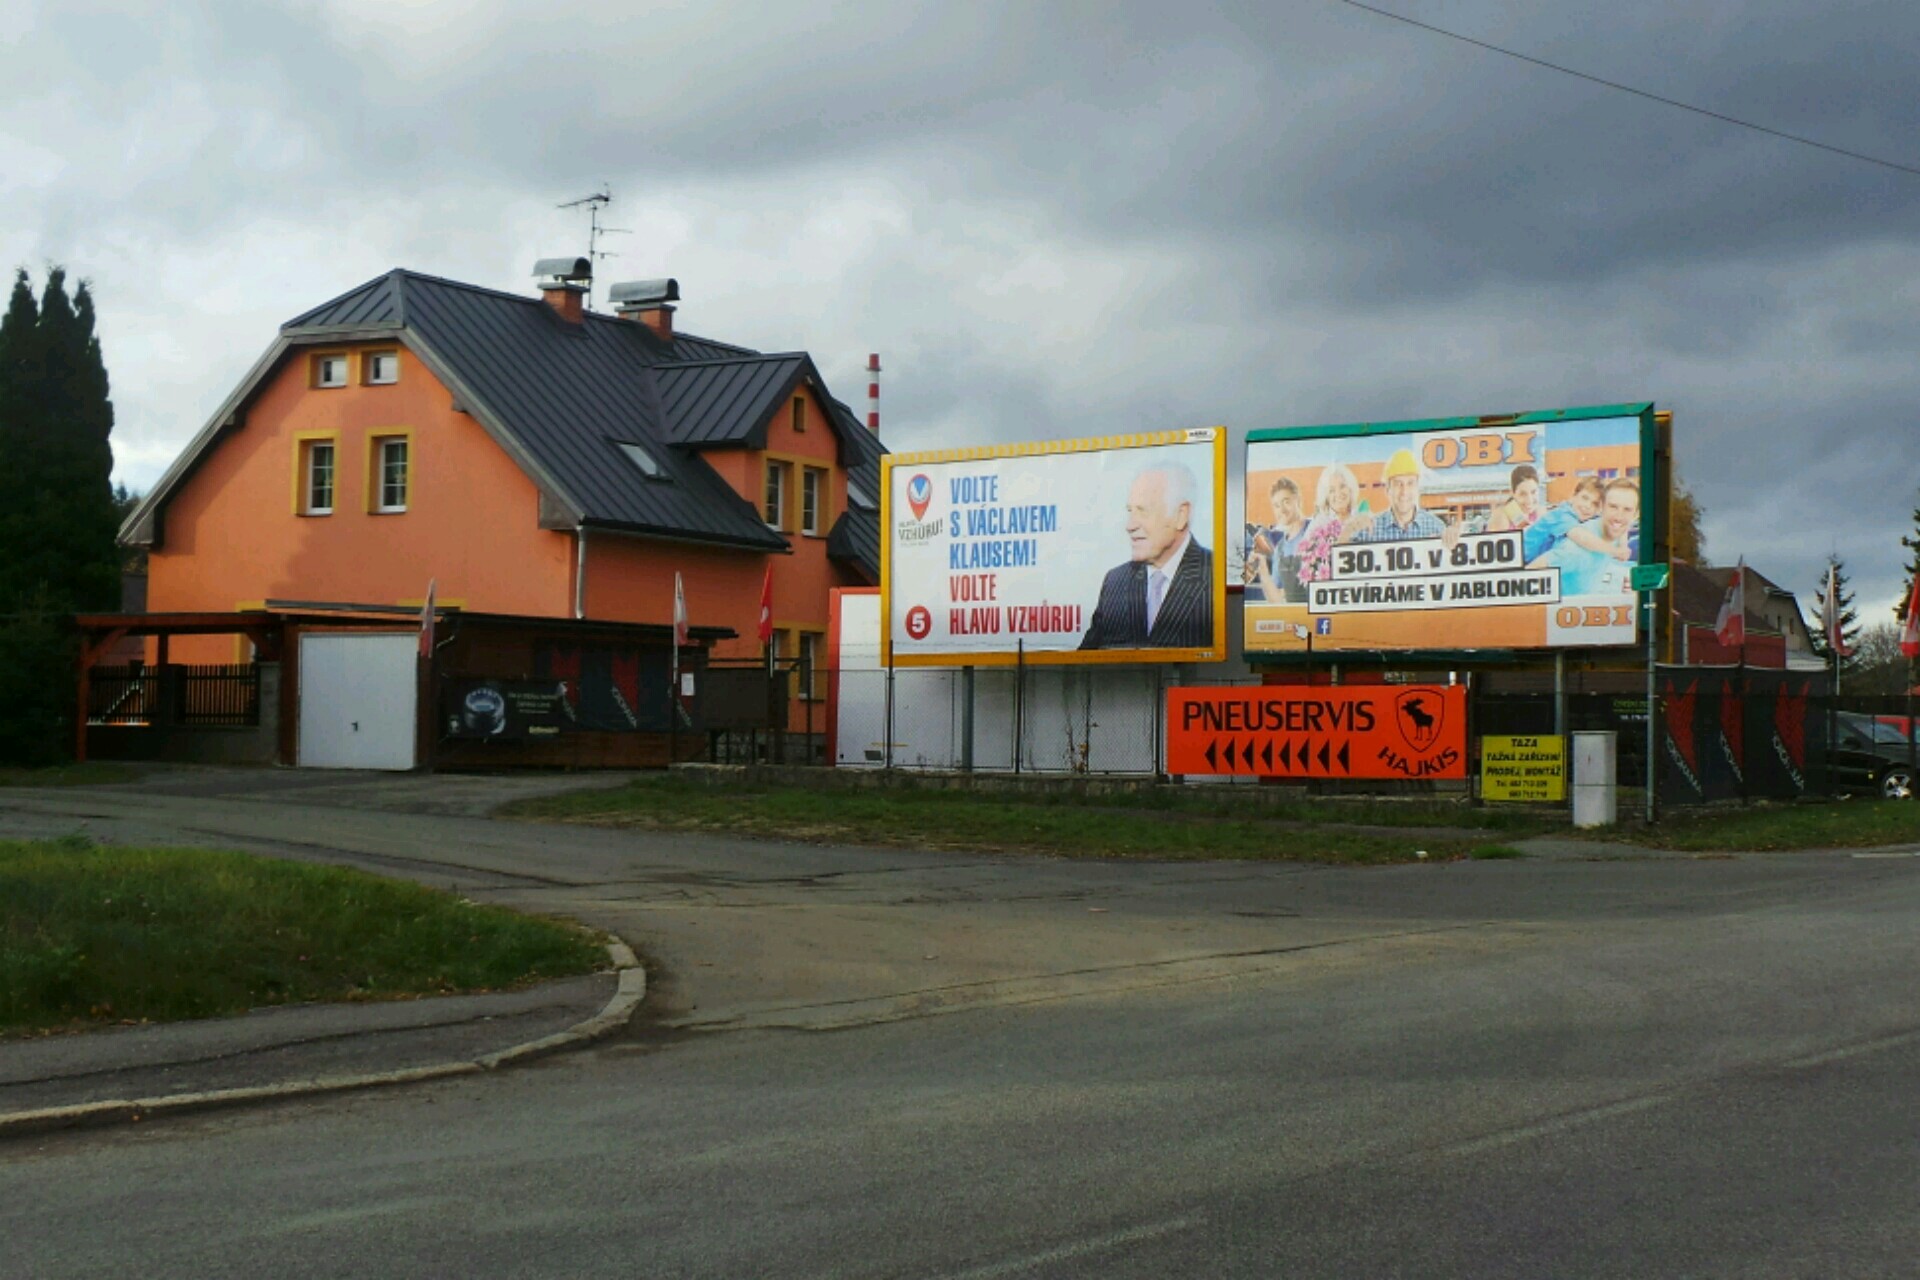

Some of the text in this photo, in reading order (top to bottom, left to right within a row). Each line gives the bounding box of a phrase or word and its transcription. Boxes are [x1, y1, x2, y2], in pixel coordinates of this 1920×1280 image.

[1422, 431, 1537, 468] OBI
[950, 475, 998, 504] VOLTE
[950, 503, 1057, 538] S VÁCLAVEM
[949, 539, 1037, 570] KLAUSEM!
[1450, 538, 1515, 566] 8.00
[949, 574, 997, 602] VOLTE
[1315, 576, 1552, 606] OTEVÍRÁME V JABLONCI!
[911, 612, 926, 633] 5
[949, 599, 1082, 635] HLAVU VZHŮRU!
[1556, 605, 1633, 629] OBI
[1182, 700, 1376, 732] PNEUSERVIS
[1510, 738, 1537, 747] TAZA
[1376, 745, 1459, 777] HAJKIS
